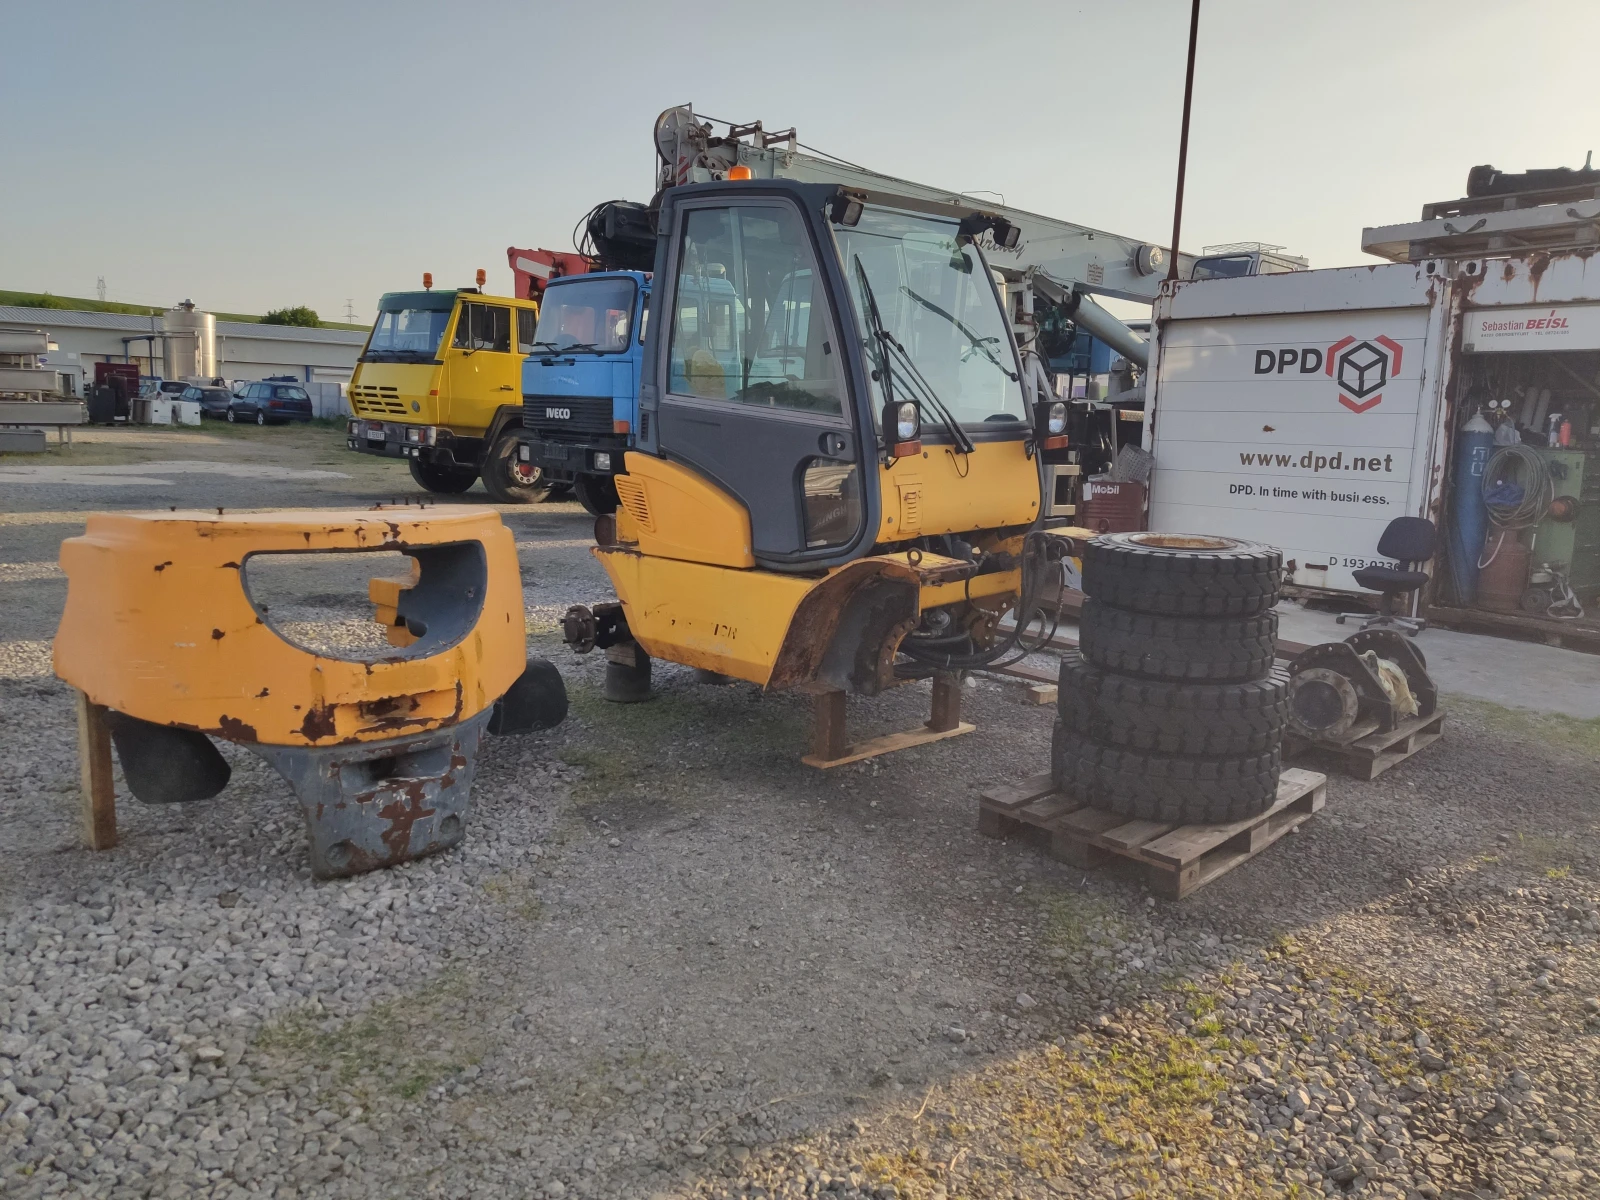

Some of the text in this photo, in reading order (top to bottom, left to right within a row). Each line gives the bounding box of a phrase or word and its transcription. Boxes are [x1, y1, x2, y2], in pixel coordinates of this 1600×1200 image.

[1482, 320, 1524, 331] Sebastian
[1254, 348, 1323, 374] DPD
[546, 407, 571, 420] IVECO
[1239, 450, 1393, 473] www.dpd.net
[1092, 484, 1120, 495] Mobil
[1229, 484, 1256, 496] DPD.
[1259, 486, 1269, 497] In
[1273, 487, 1298, 498] time
[1302, 489, 1327, 501] with
[1329, 556, 1338, 566] D
